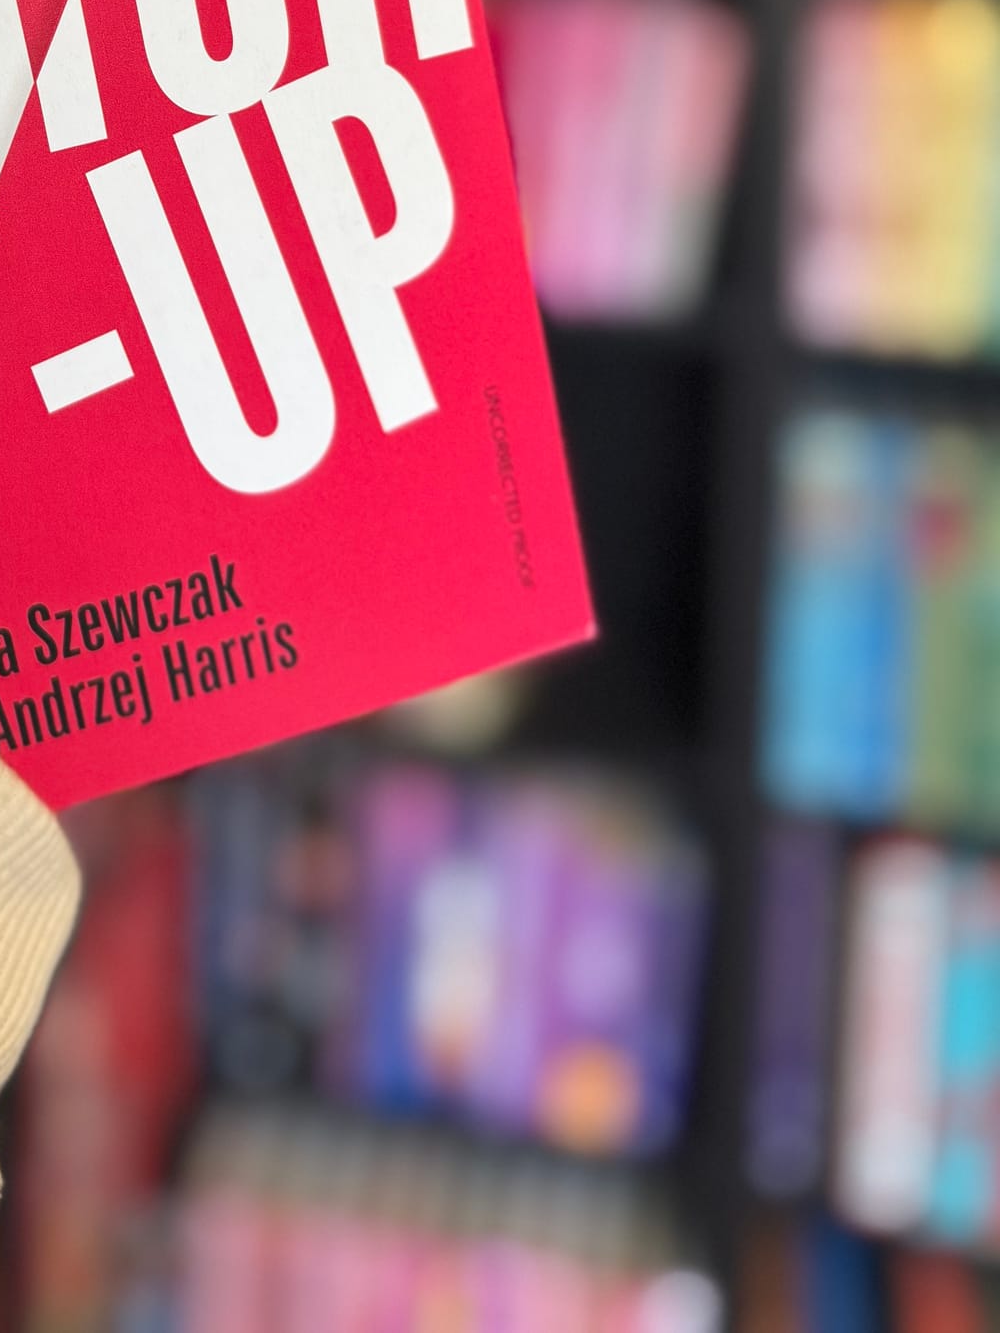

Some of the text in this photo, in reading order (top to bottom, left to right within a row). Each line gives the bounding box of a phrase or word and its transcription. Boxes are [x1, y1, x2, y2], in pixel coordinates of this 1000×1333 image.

[31, 64, 455, 494] -UP
[483, 385, 521, 525] UNCORRECTED
[27, 554, 244, 666] Szewczak
[161, 617, 299, 703] Harris
